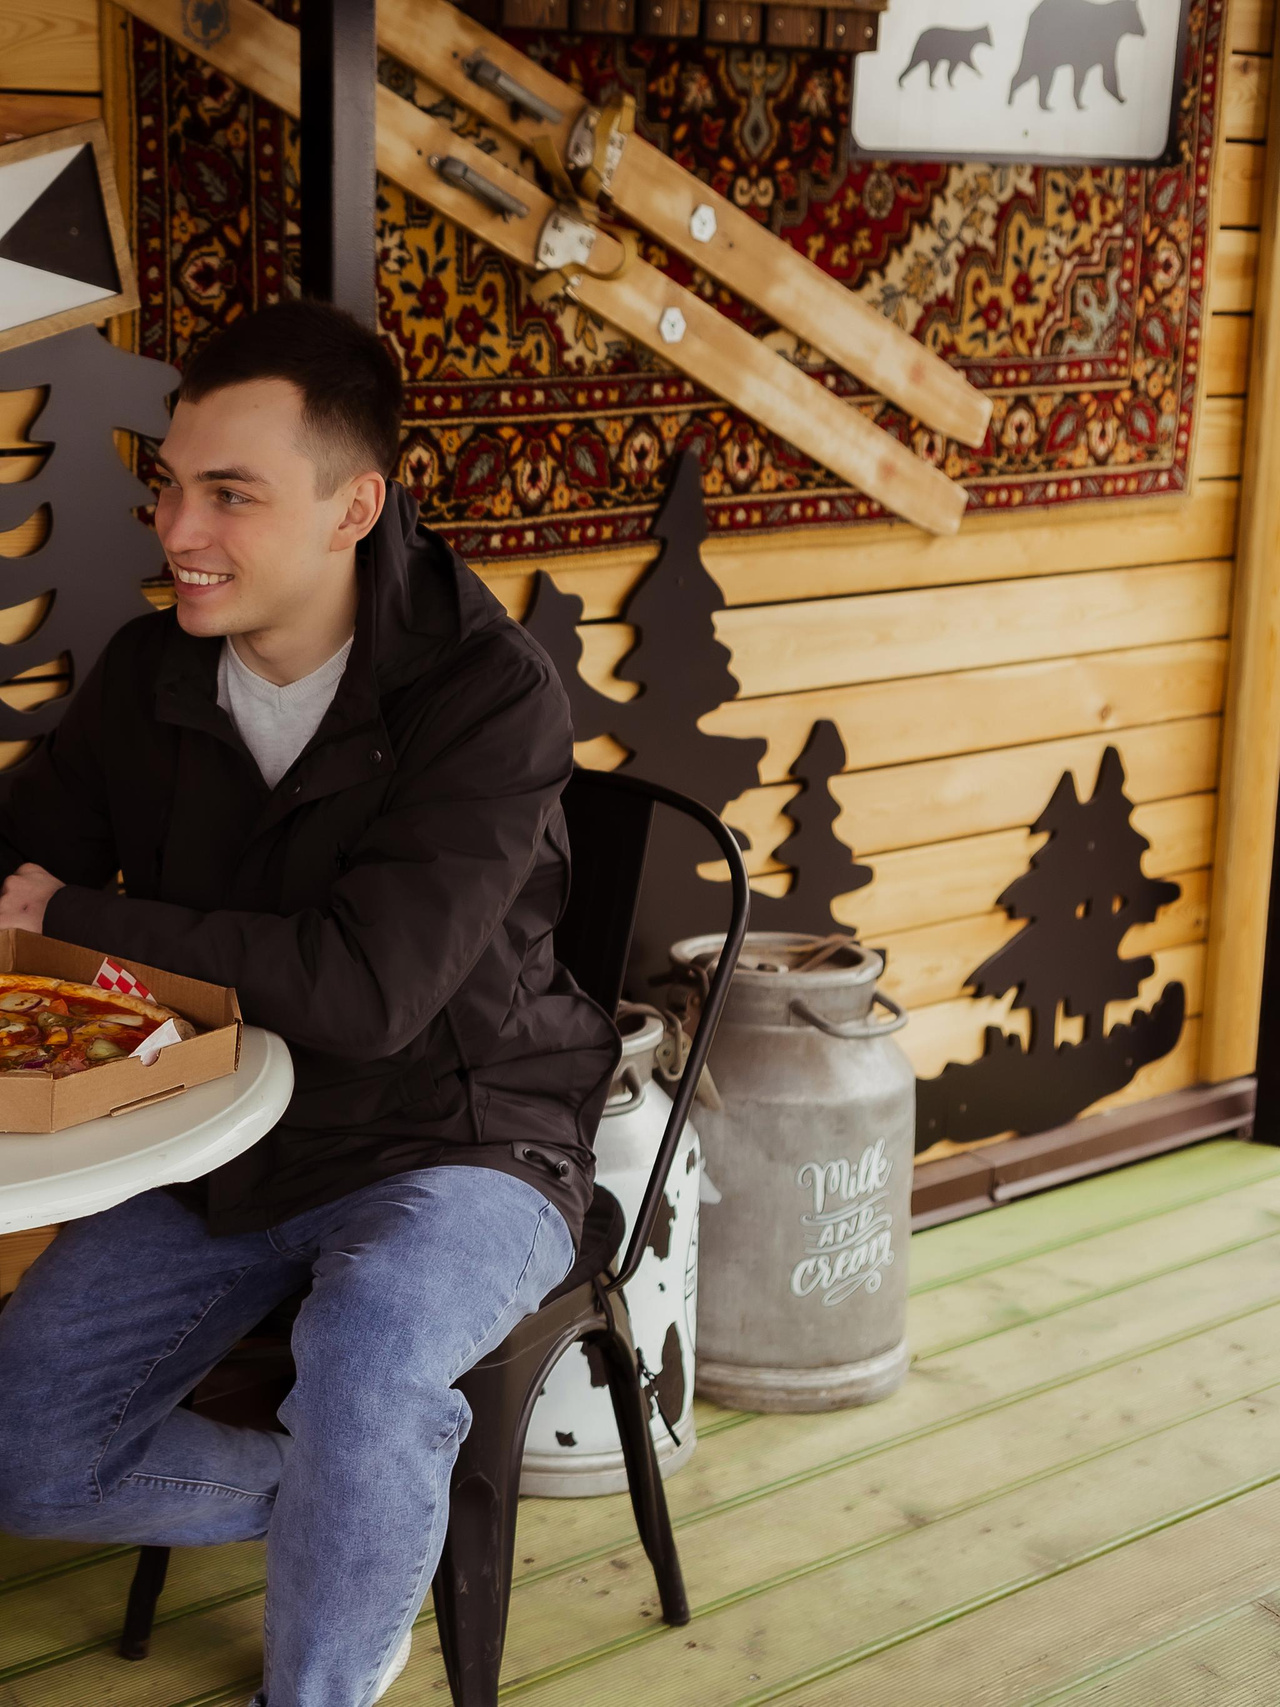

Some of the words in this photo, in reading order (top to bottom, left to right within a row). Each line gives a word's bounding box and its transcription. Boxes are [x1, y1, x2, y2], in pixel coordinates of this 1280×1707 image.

[797, 1136, 893, 1214] Milk
[817, 1205, 875, 1248] AND
[790, 1229, 894, 1307] Cream
